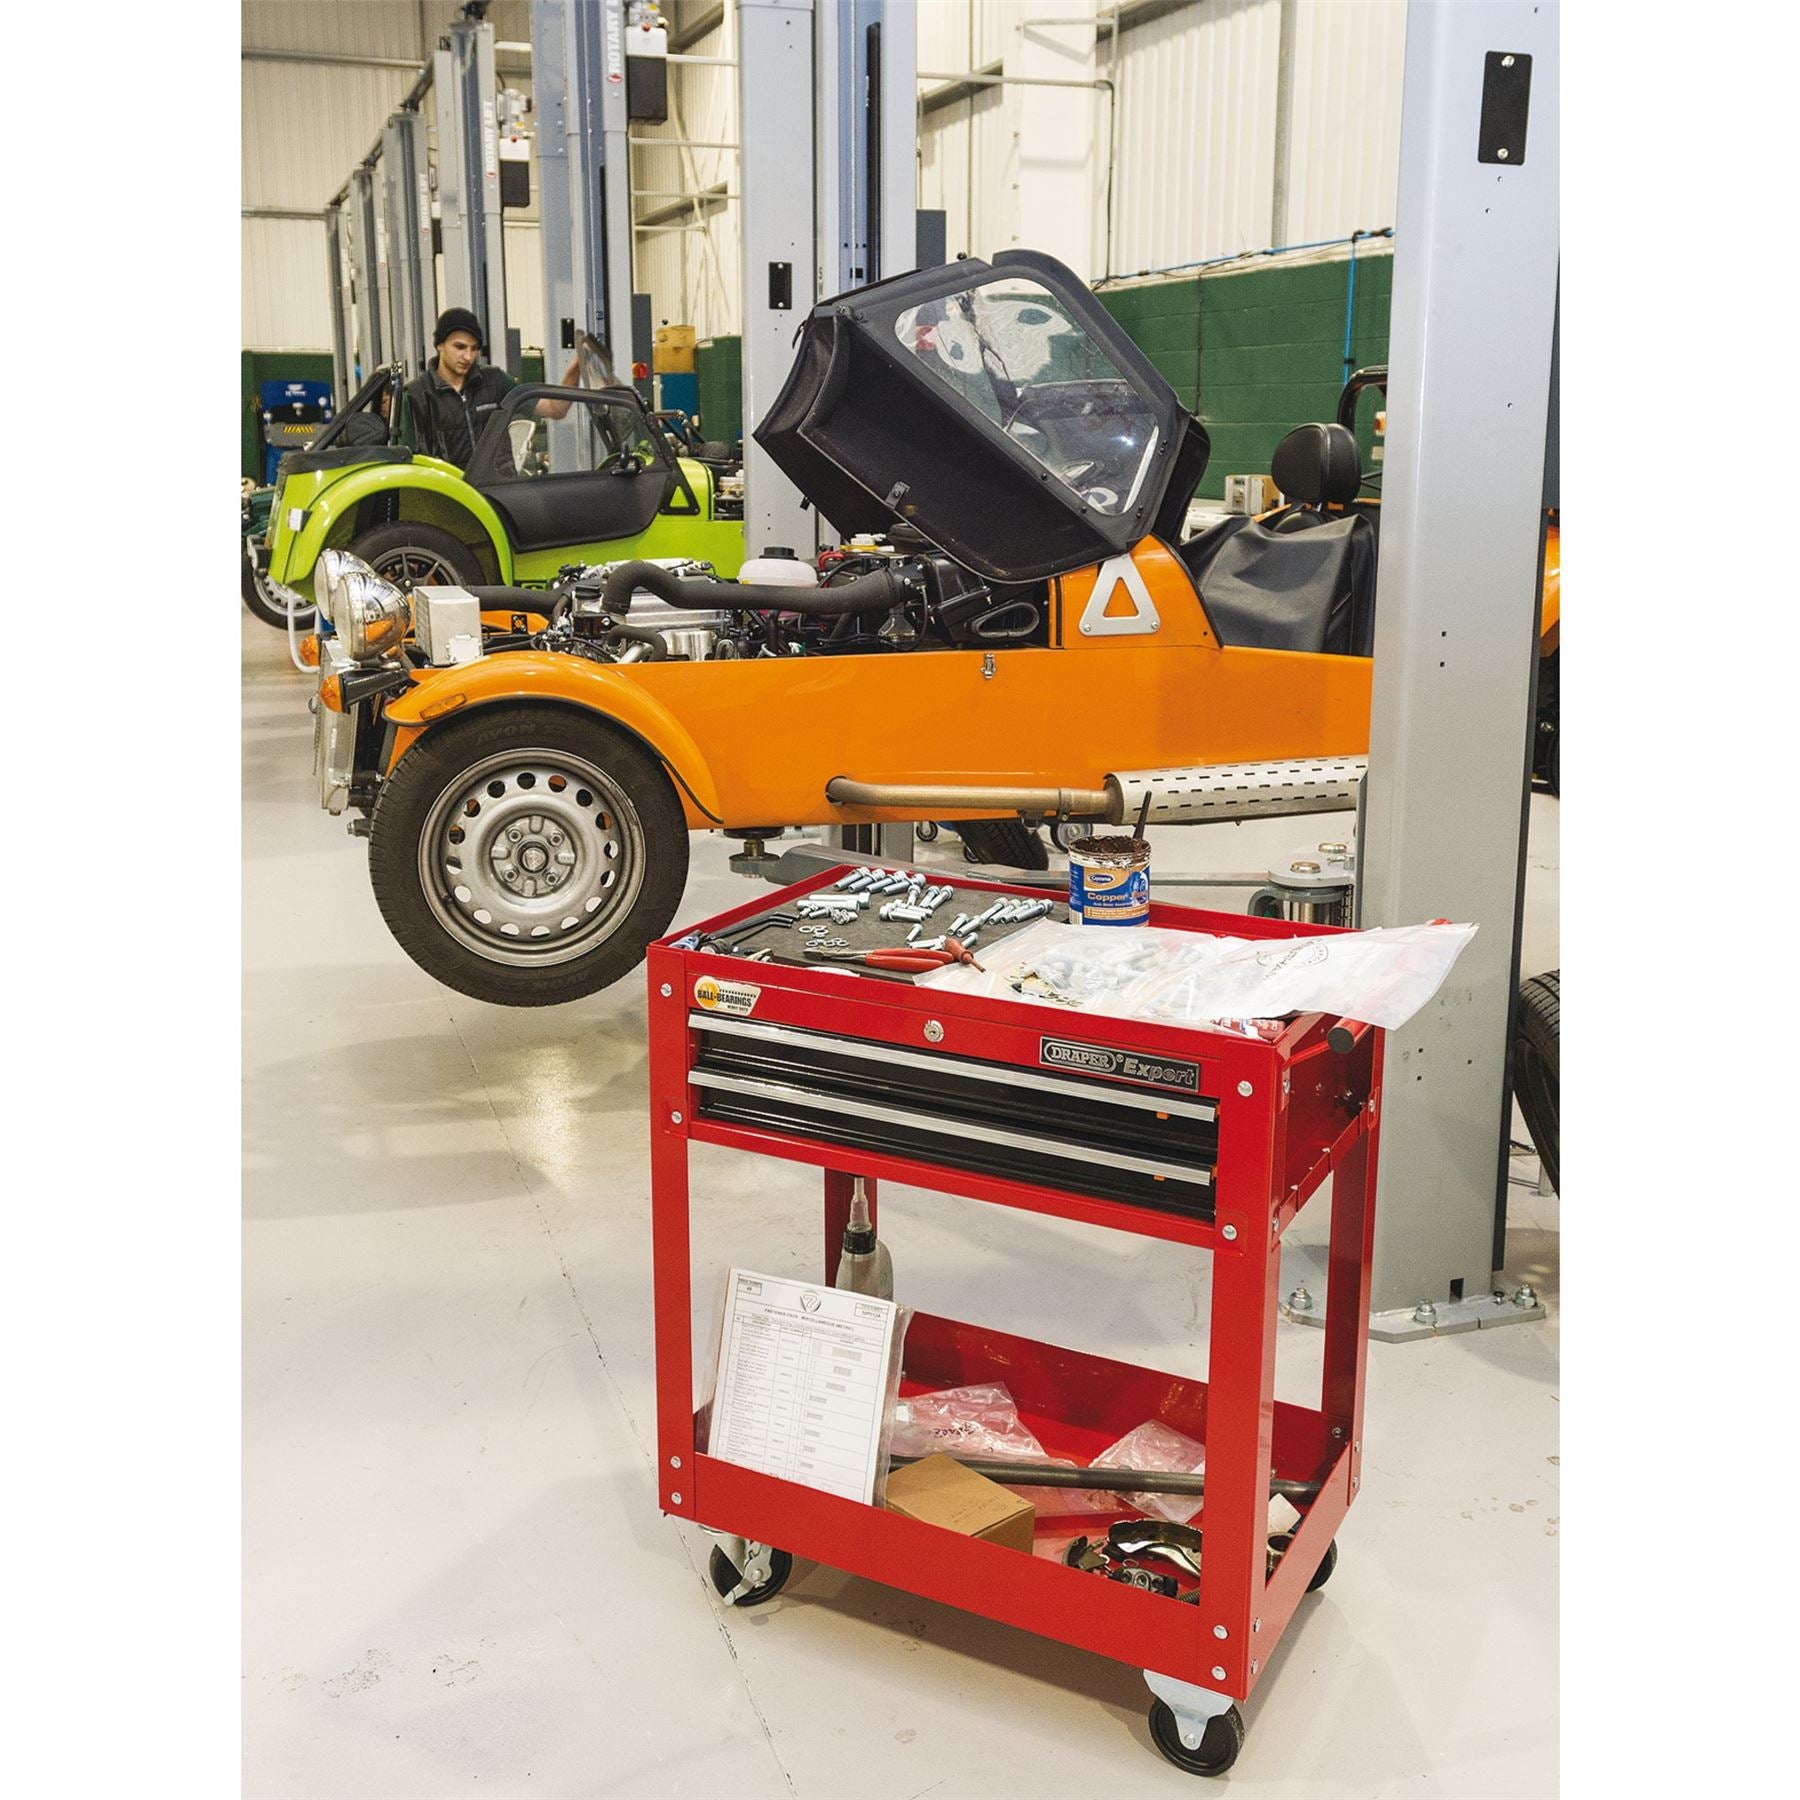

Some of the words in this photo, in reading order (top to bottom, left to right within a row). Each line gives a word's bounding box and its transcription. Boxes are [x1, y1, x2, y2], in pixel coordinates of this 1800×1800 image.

[1087, 892, 1126, 902] Copper
[697, 989, 752, 1007] BALL-BEARINGS
[1051, 1046, 1110, 1068] DRAPER
